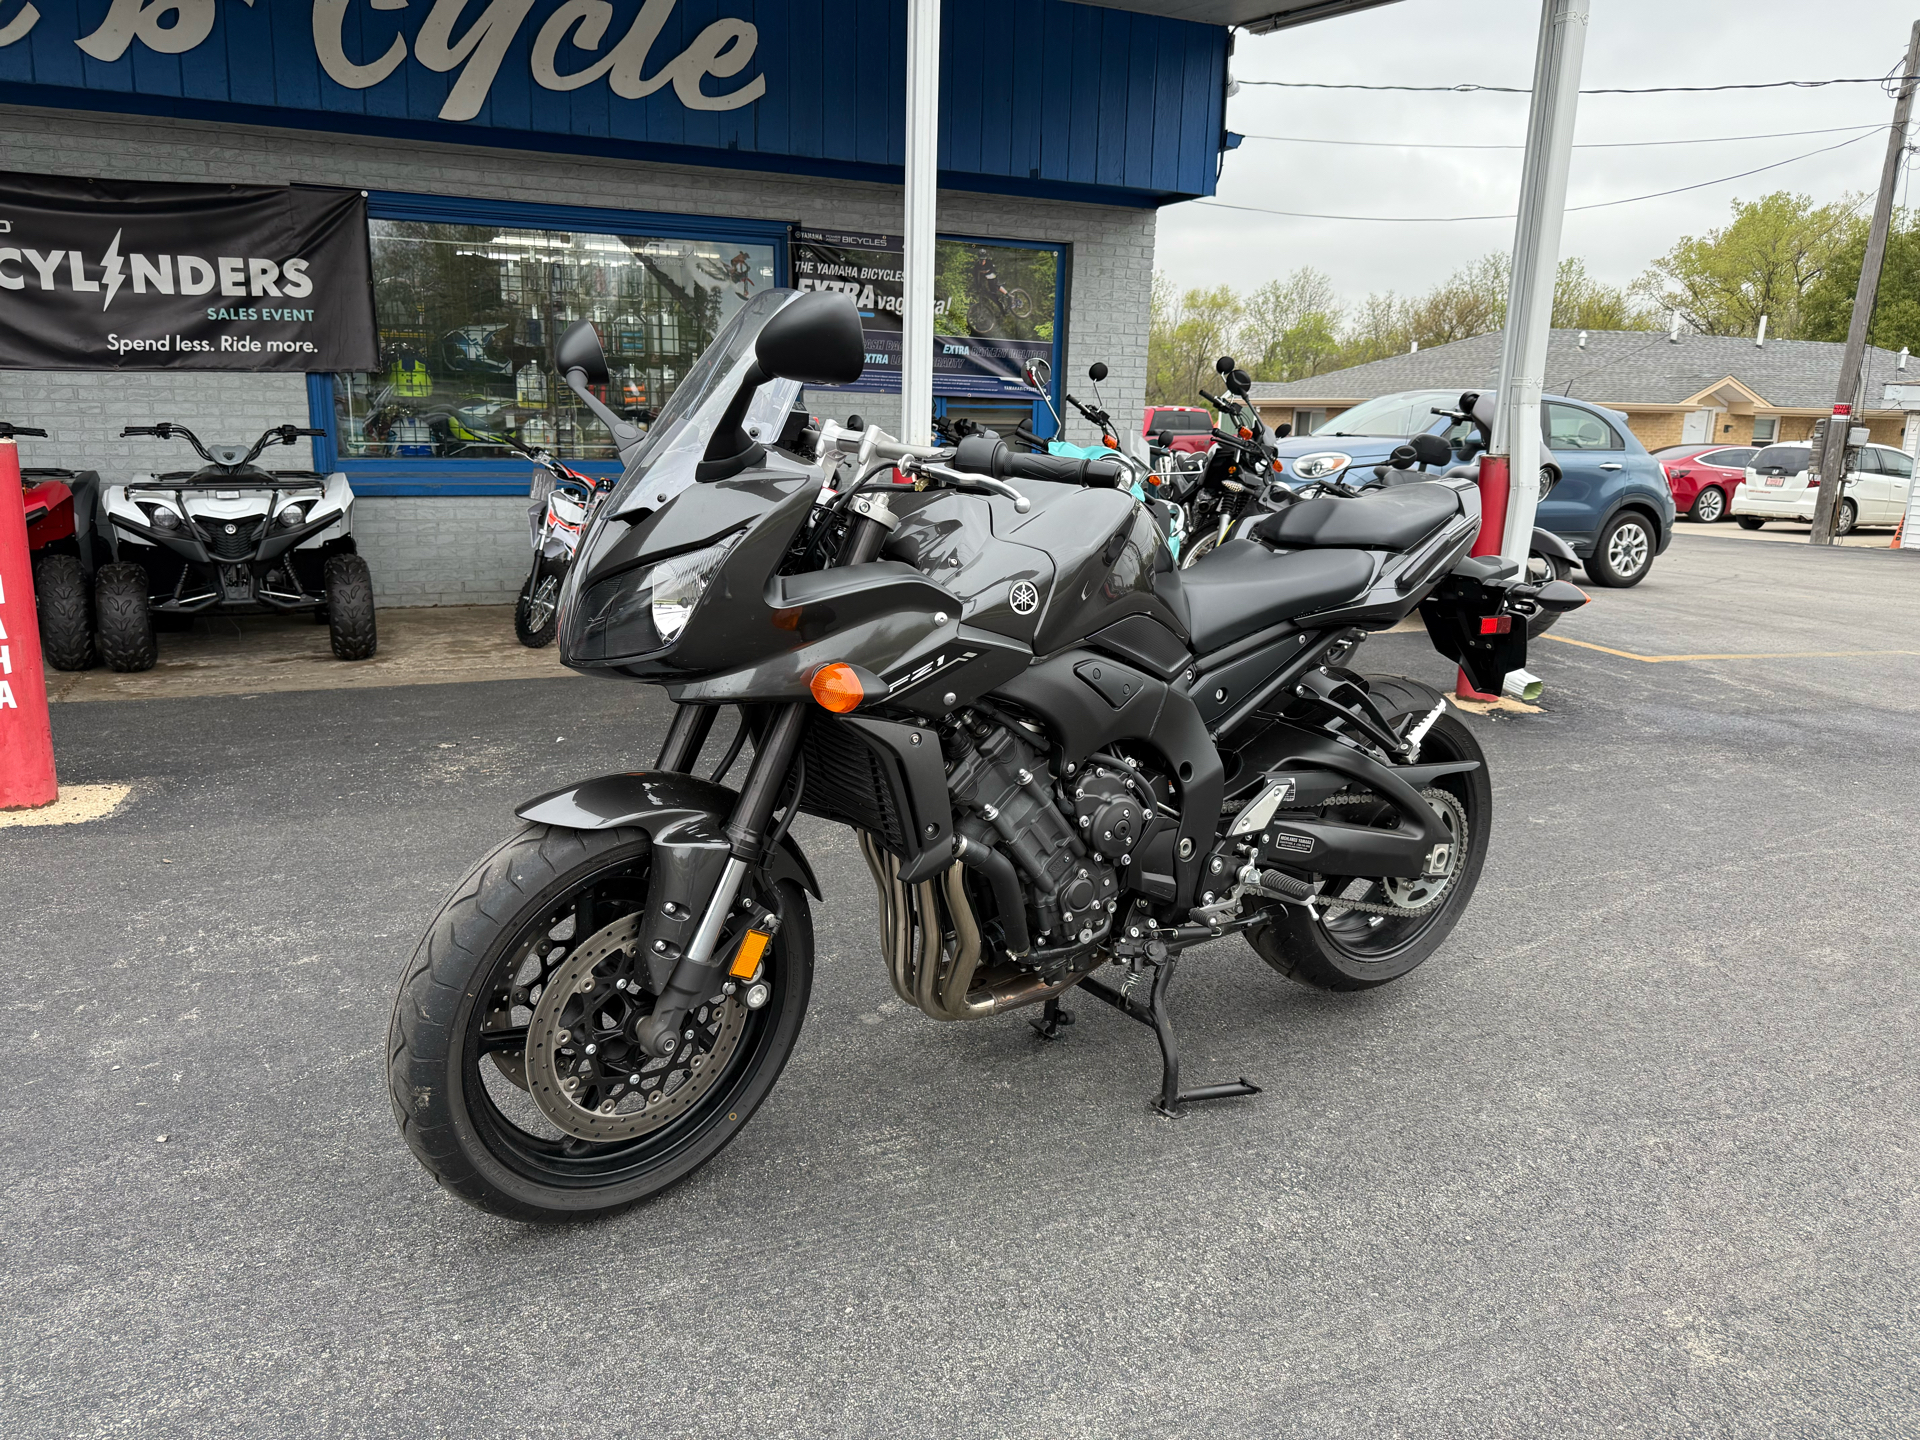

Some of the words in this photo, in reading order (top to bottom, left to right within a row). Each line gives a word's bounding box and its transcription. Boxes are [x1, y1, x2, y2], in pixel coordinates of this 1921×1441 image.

[313, 0, 766, 121] Cycle
[841, 235, 887, 247] BICYCLES
[795, 261, 815, 274] THE
[816, 262, 858, 278] YAMAHA
[207, 308, 258, 321] SALES
[262, 308, 315, 322] EVENT
[106, 333, 171, 356] Spend
[175, 335, 215, 352] less.
[221, 335, 262, 353] Ride
[267, 339, 319, 354] more.
[943, 344, 969, 356] EXTRA
[971, 346, 1008, 358] BATTERY
[1009, 348, 1048, 360] INCLUDED
[864, 352, 889, 365] XTRA
[888, 654, 945, 694] FZ1
